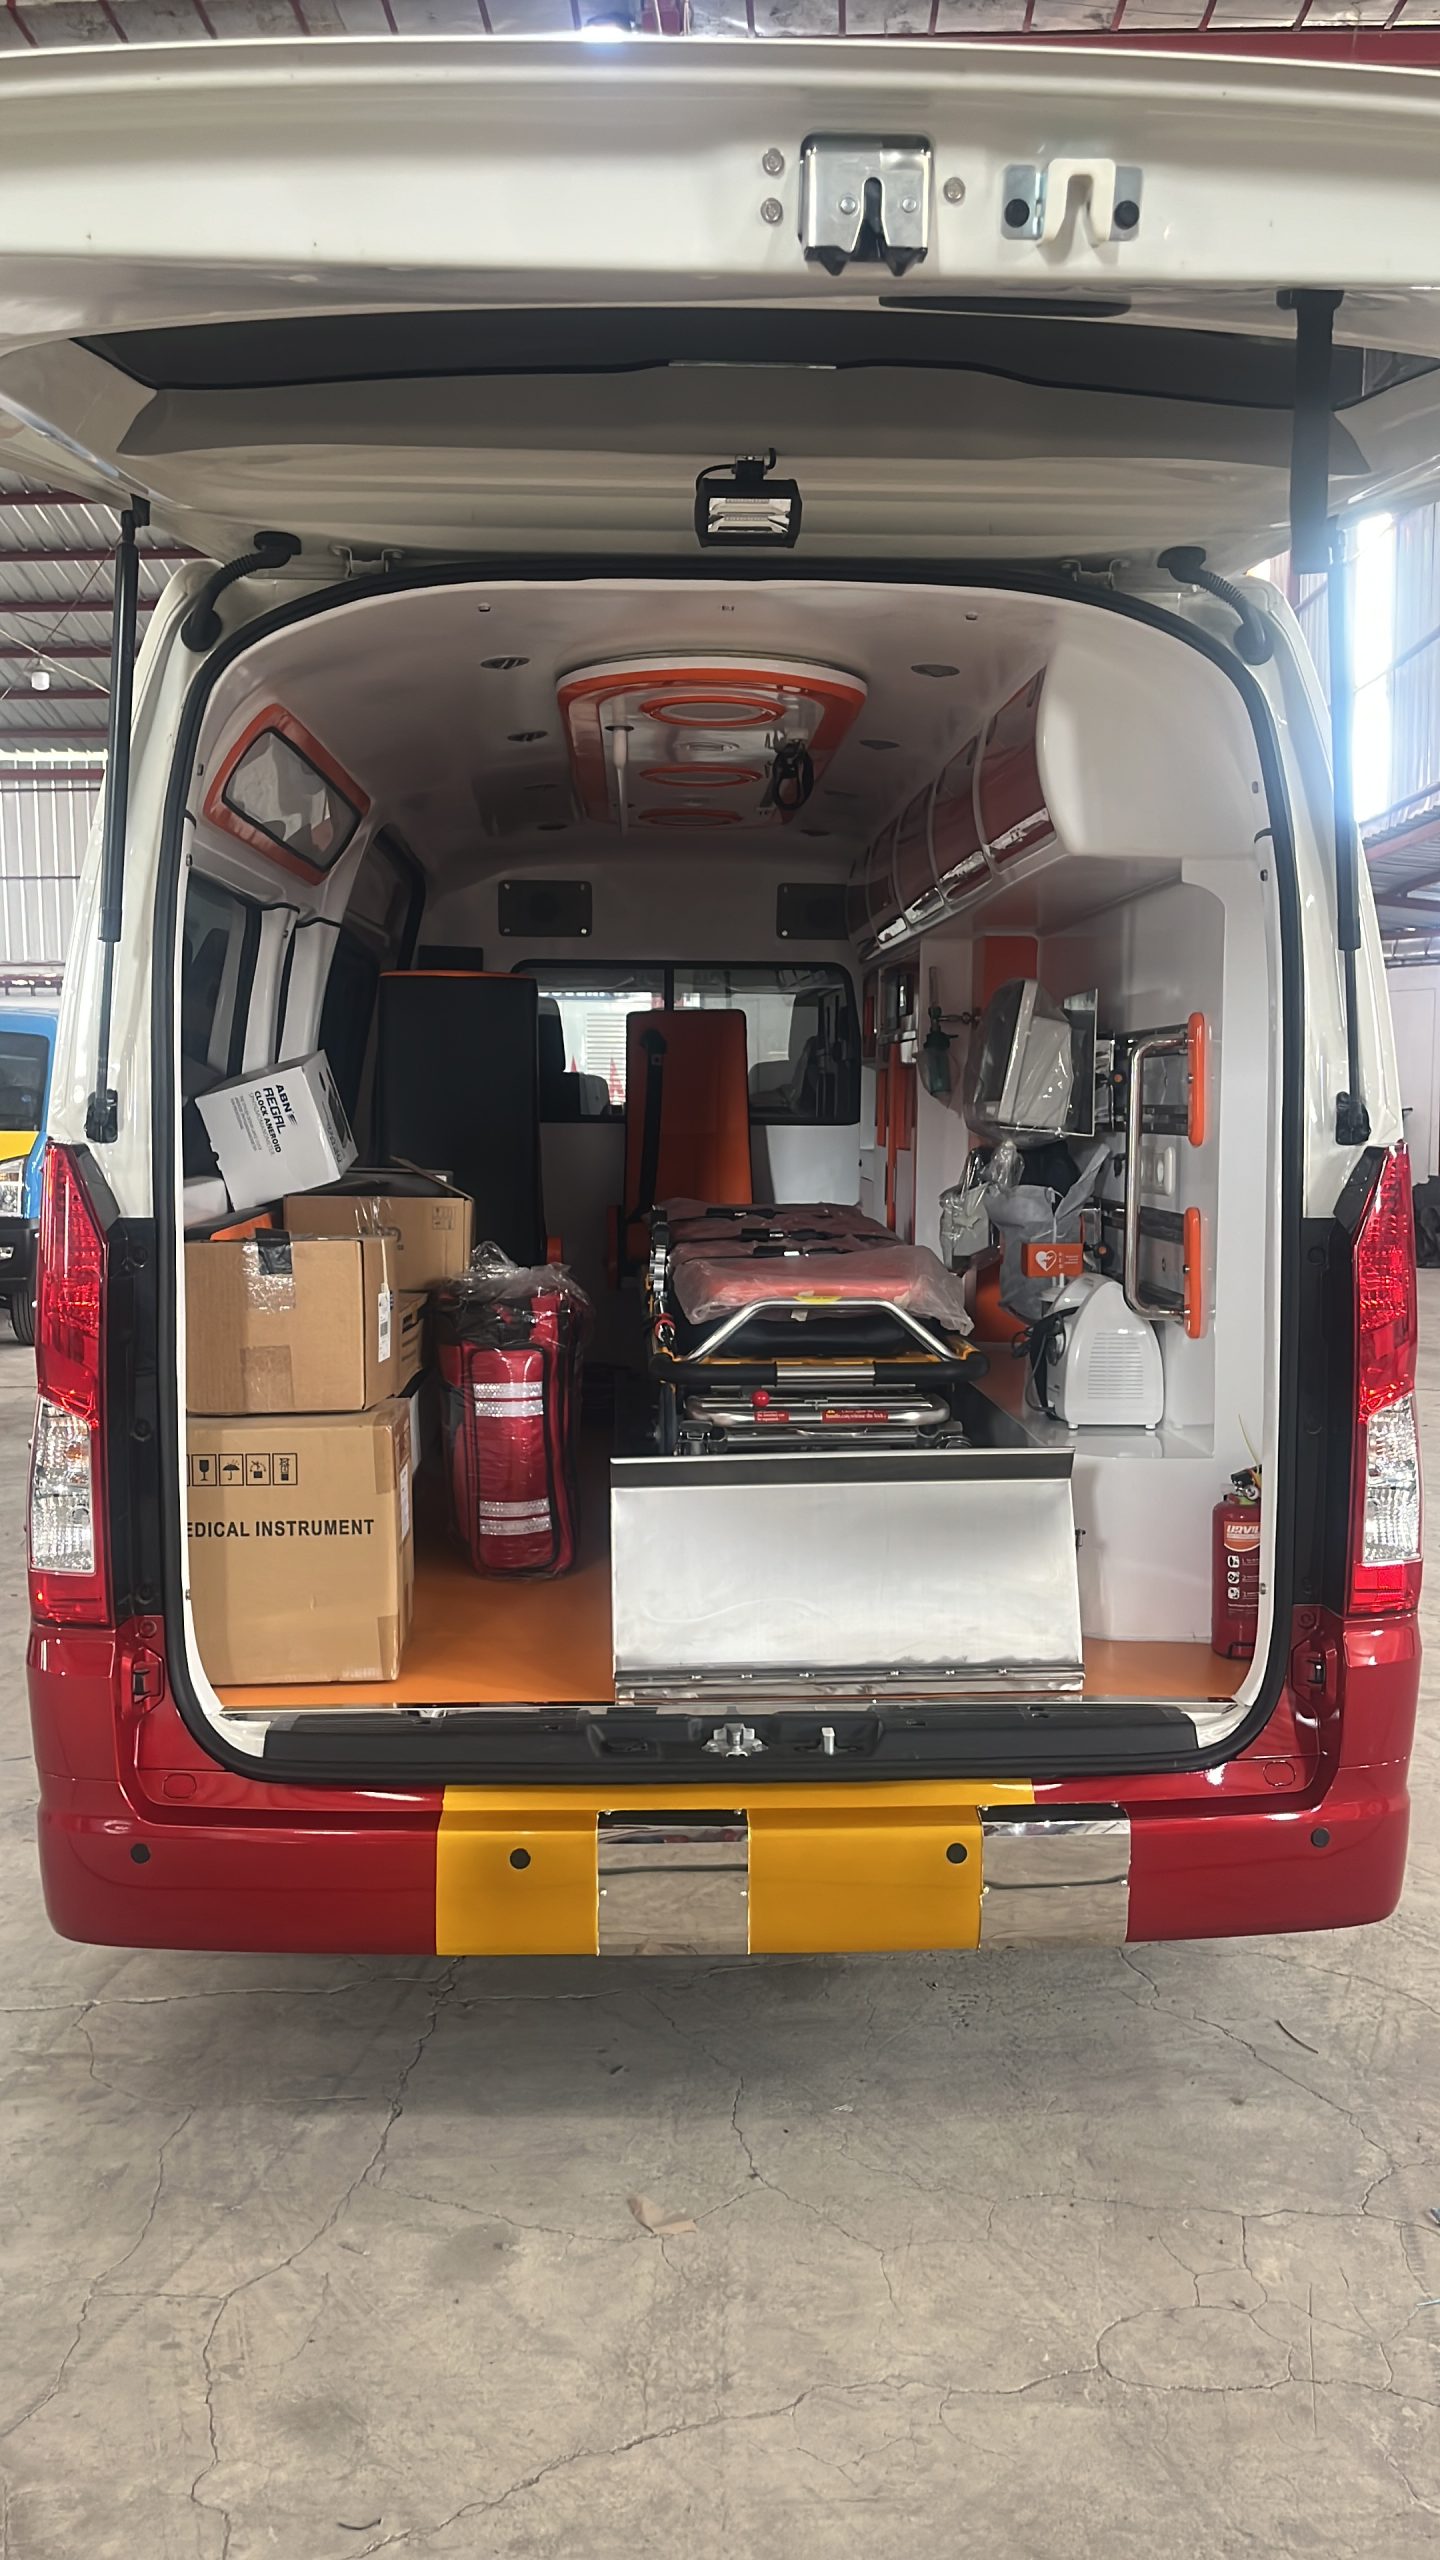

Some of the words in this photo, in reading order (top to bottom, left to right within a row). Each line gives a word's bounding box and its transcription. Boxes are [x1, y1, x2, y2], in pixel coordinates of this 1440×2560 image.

[263, 1087, 286, 1134] REGAL
[276, 1084, 292, 1113] ABN
[254, 1090, 269, 1117] CLOCK
[264, 1117, 282, 1153] ANEROID
[255, 1519, 375, 1537] INSTRUMENT
